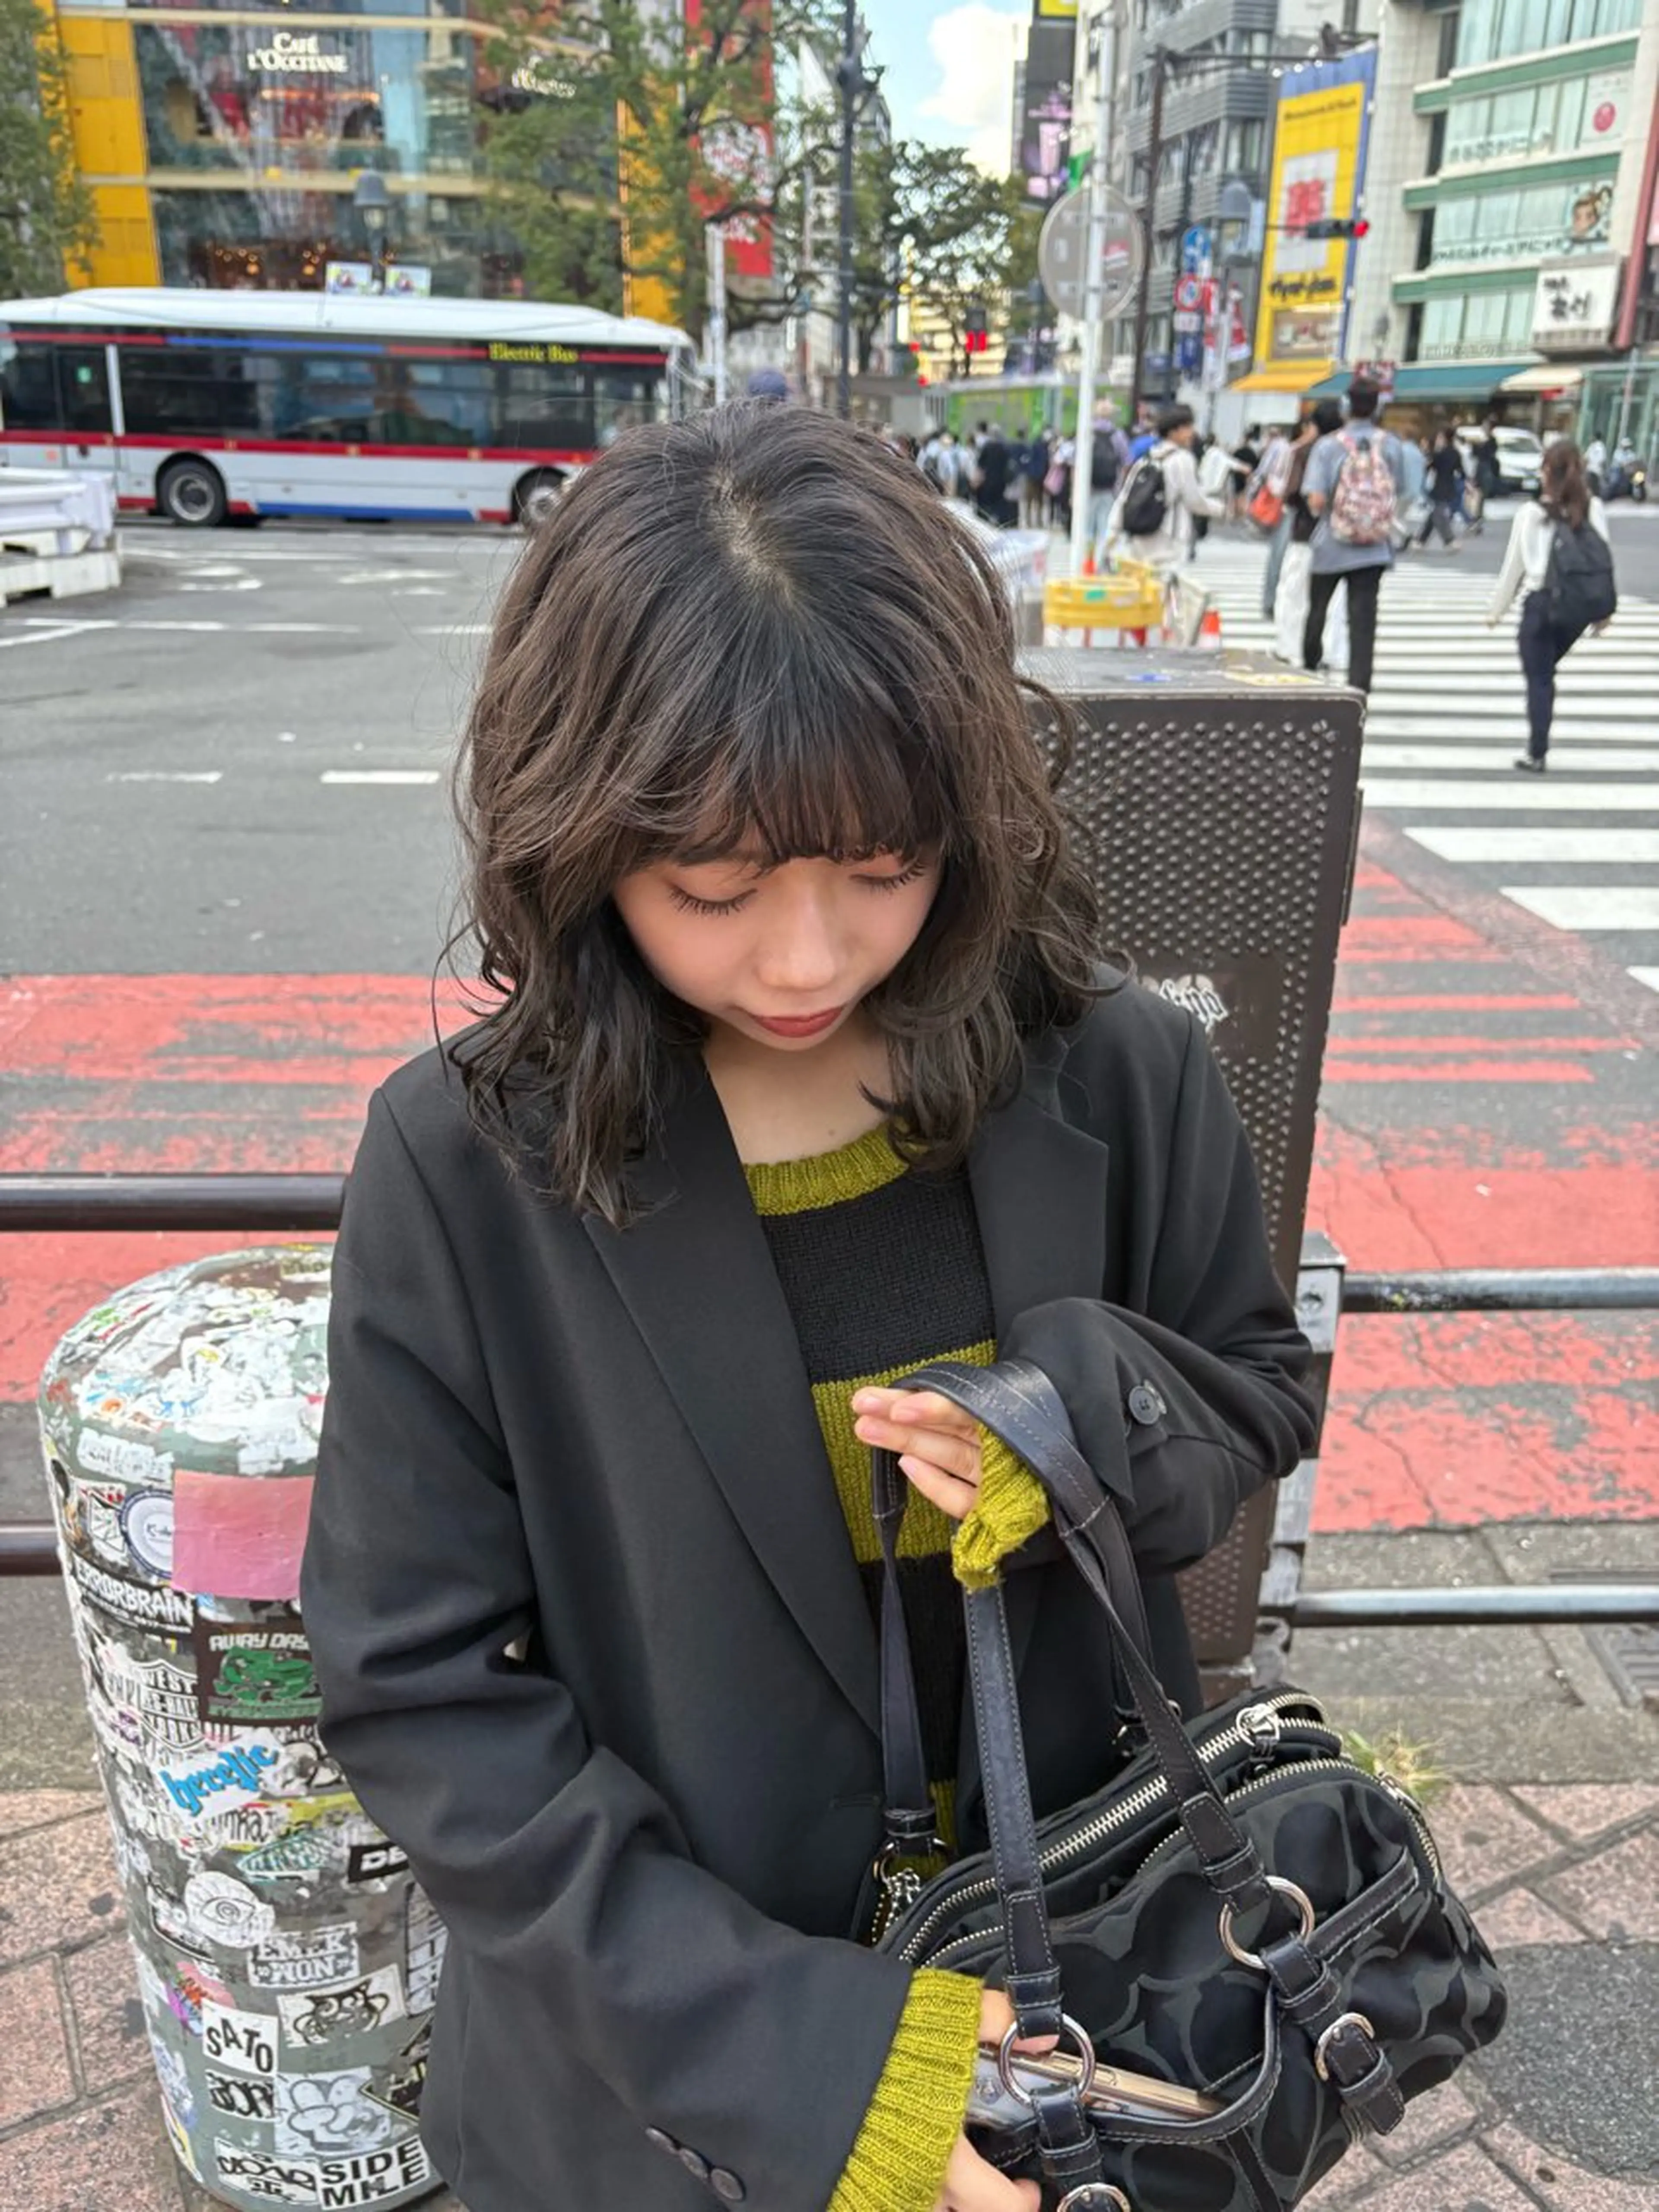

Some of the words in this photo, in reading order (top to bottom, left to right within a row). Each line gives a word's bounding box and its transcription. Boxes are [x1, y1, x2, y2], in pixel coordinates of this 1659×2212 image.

[489, 342, 544, 362] Electric
[548, 343, 578, 364] Bus
[207, 2018, 273, 2073] SATO
[322, 2138, 422, 2184] SIDE
[322, 2158, 426, 2207] MILE
